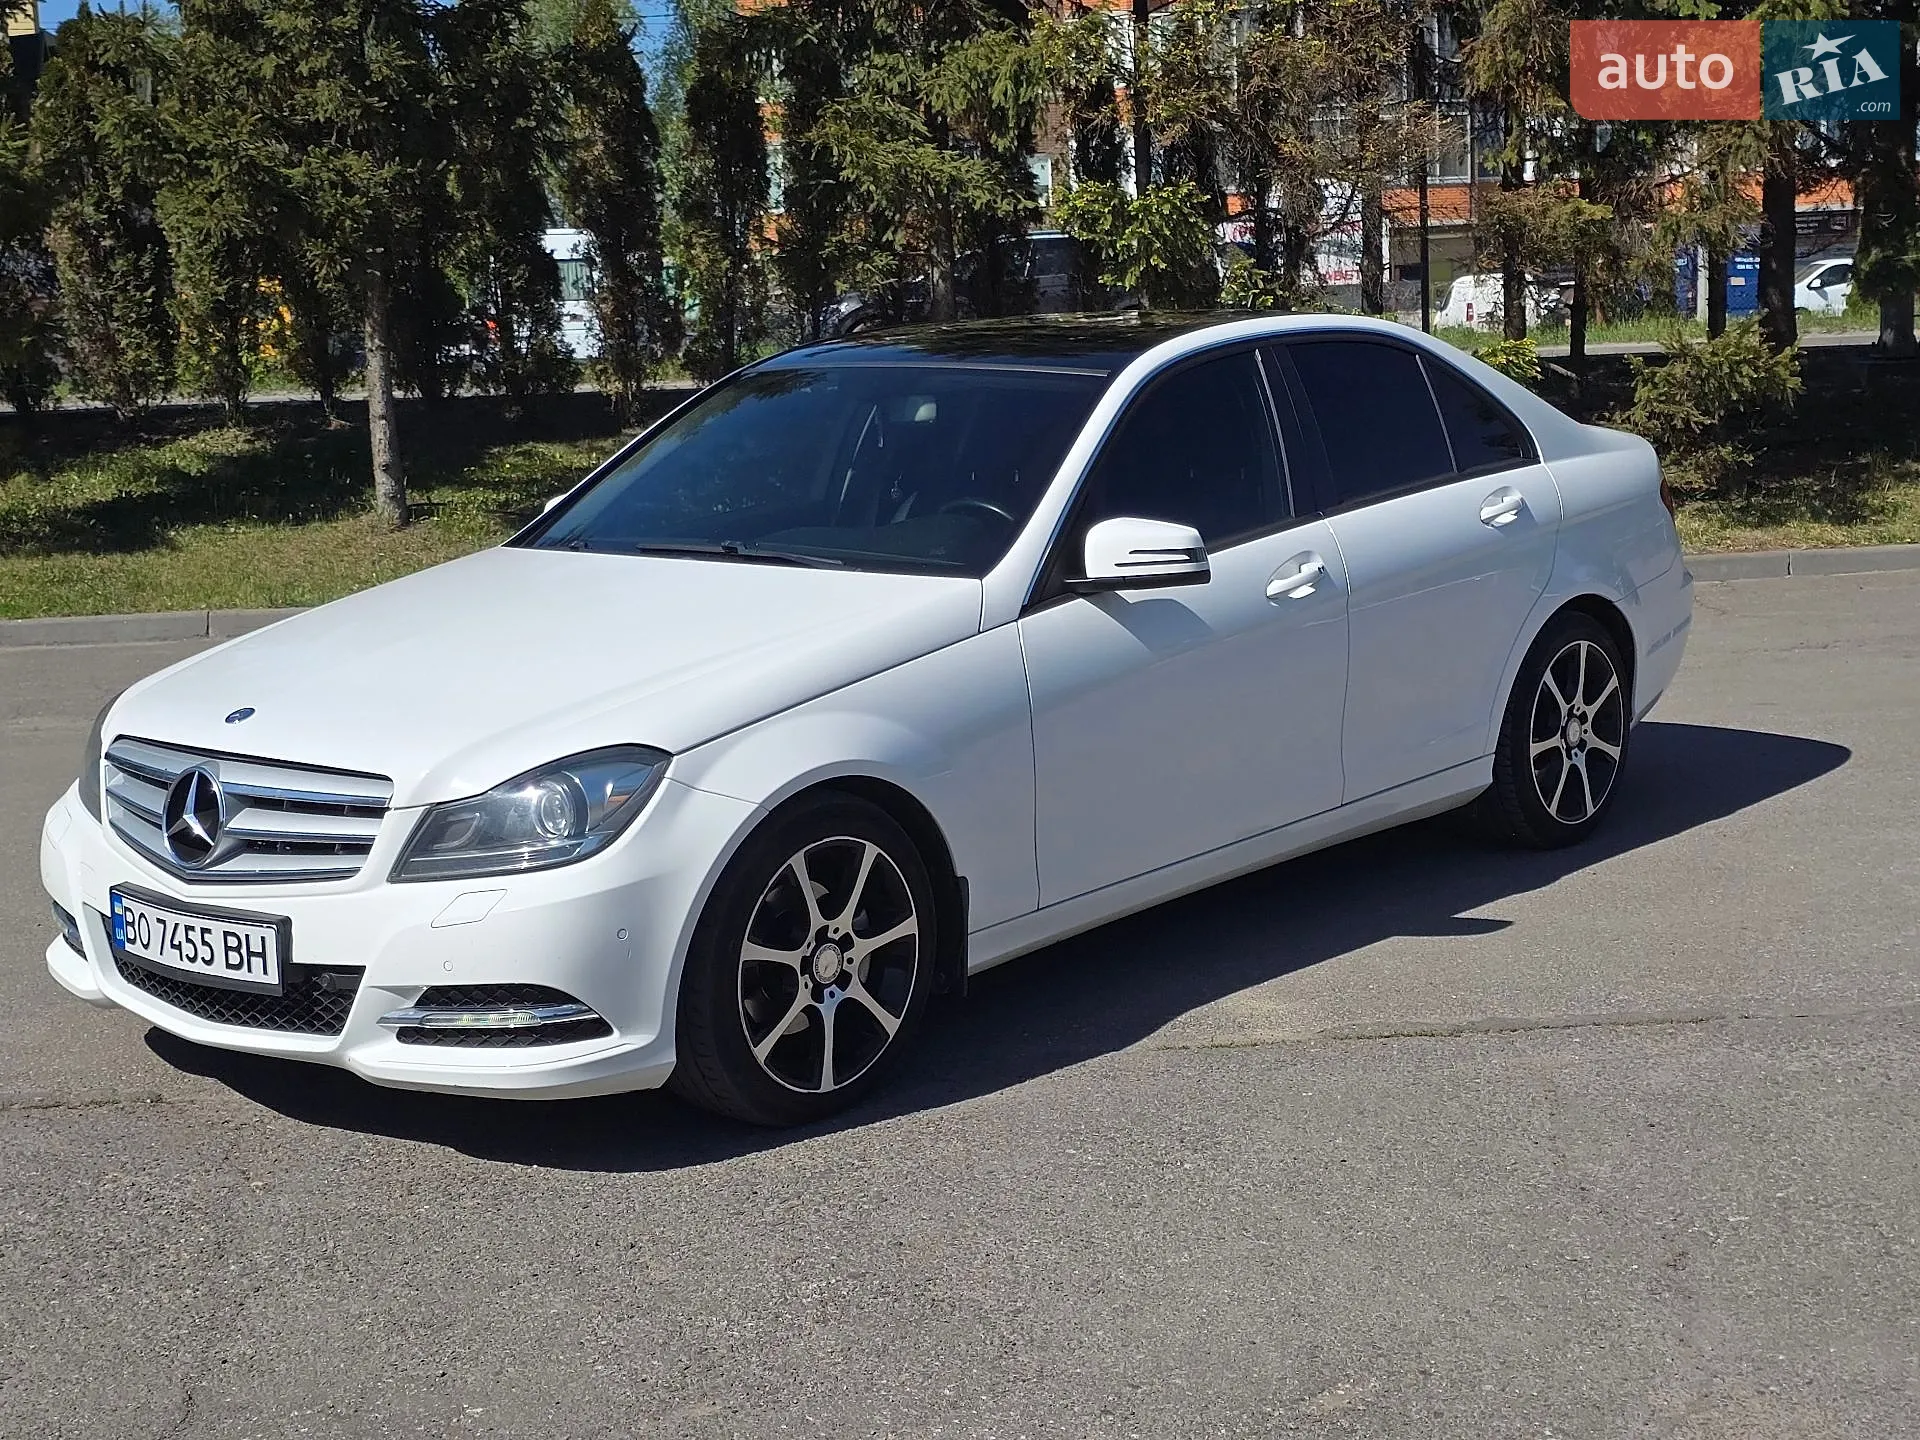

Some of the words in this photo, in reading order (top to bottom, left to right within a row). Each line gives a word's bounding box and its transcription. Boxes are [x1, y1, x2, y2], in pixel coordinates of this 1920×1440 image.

[115, 927, 125, 942] UA
[156, 917, 215, 966] 7455
[222, 930, 269, 976] BH
